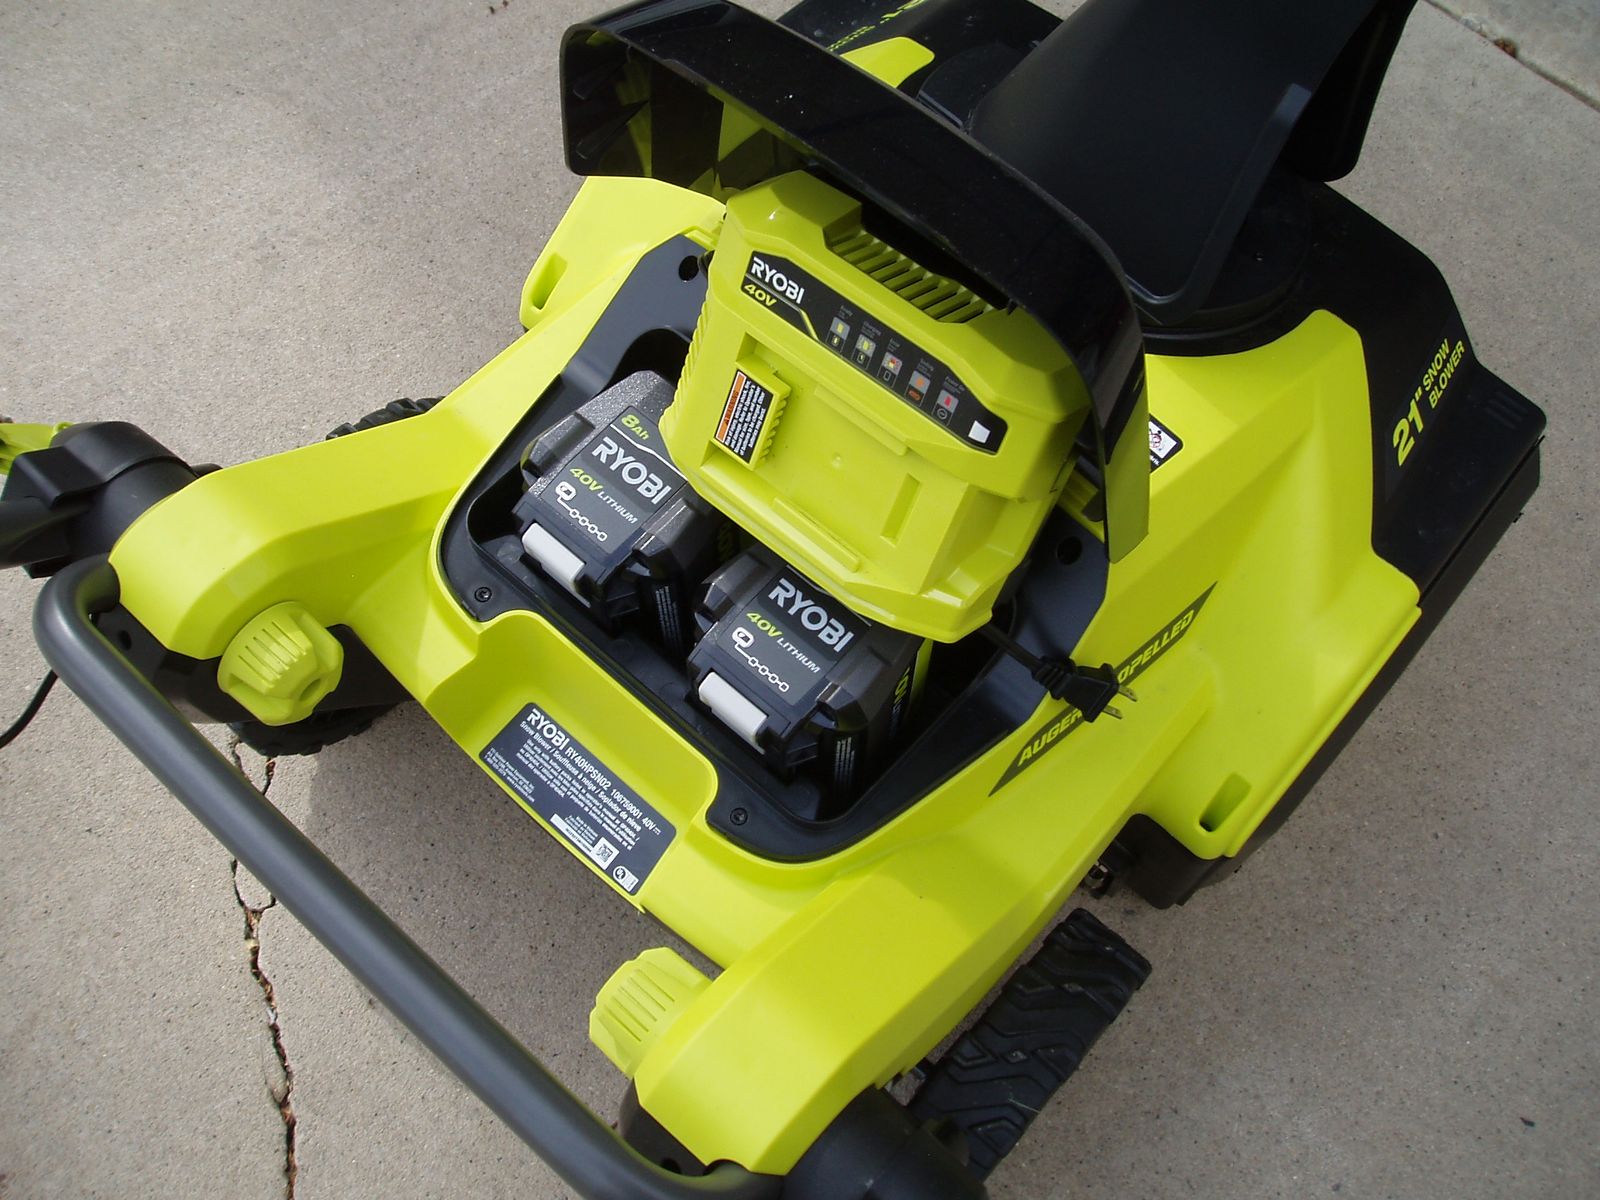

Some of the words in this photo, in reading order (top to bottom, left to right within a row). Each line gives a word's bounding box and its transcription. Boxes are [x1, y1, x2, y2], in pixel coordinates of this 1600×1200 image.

[744, 284, 776, 306] 40V
[750, 256, 804, 304] RYOBI
[1392, 387, 1423, 466] 21"
[1422, 338, 1449, 391] SNOW
[1428, 340, 1465, 408] BLOWER
[620, 413, 650, 440] 8Ah
[568, 468, 603, 491] 40V
[596, 491, 637, 524] LITHIUM
[591, 435, 671, 504] RYOBI
[745, 612, 783, 637] 40V
[776, 637, 820, 673] LITHIUM
[767, 577, 854, 652] RYOBI
[519, 720, 535, 736] Snow
[532, 732, 552, 751] Blower
[580, 776, 597, 792] neige
[618, 810, 628, 820] de
[526, 707, 570, 750] RYOBI
[564, 746, 612, 790] RY40HPSN02
